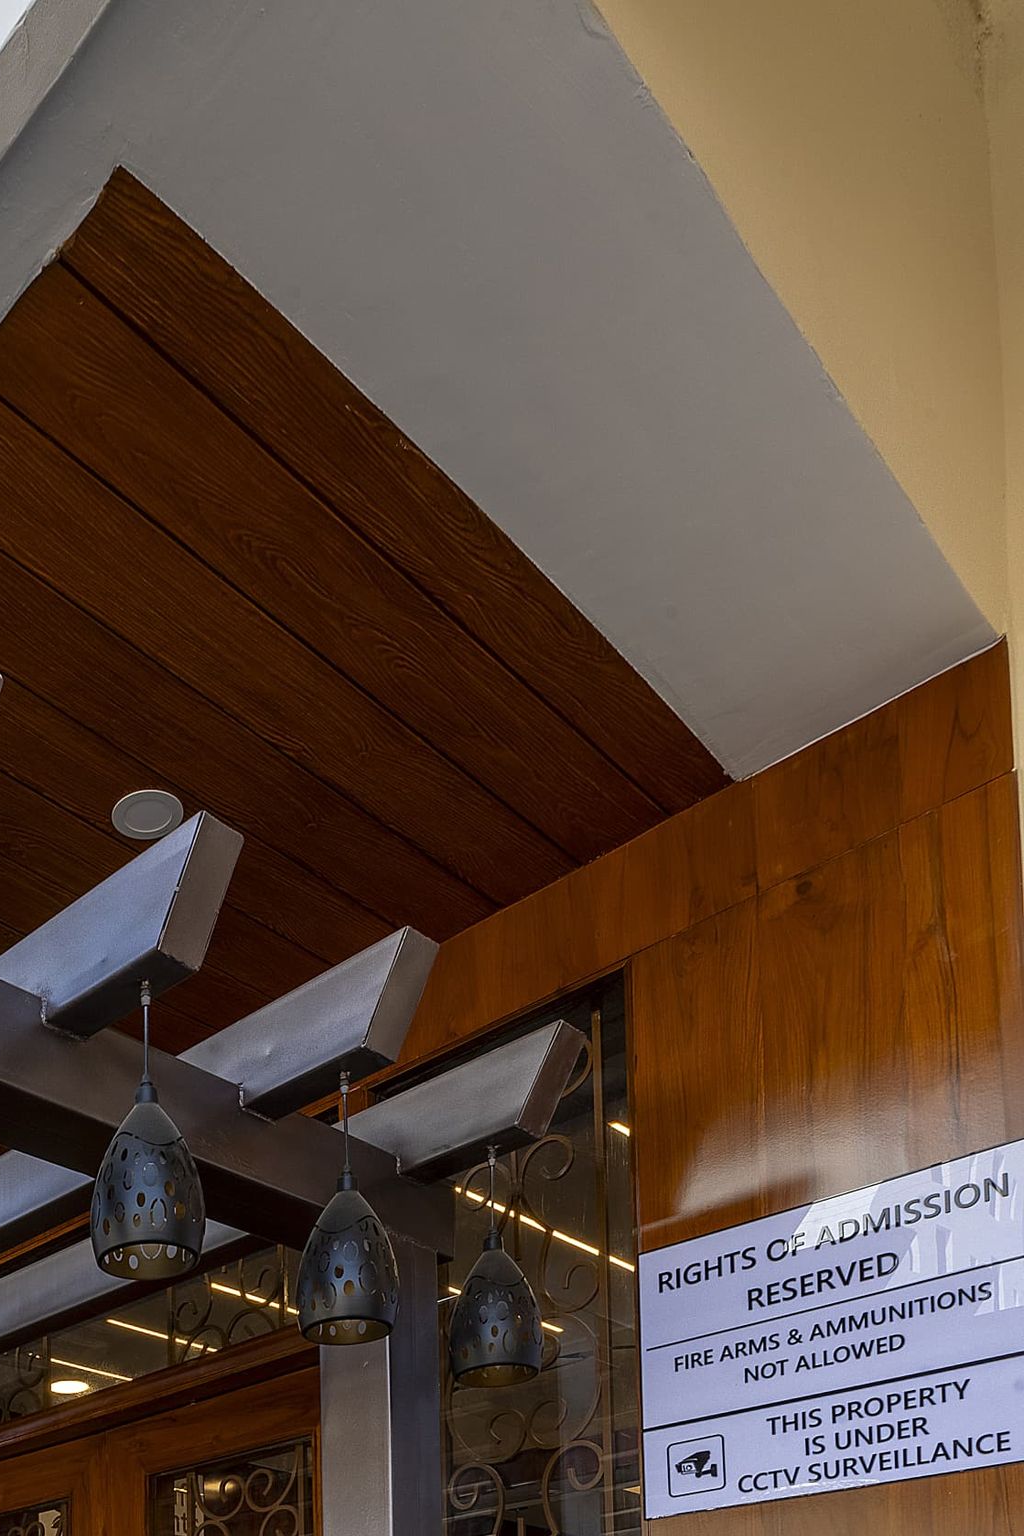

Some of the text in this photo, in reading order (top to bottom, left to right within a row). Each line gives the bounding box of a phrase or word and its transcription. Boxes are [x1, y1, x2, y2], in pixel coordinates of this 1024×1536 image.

[657, 1171, 1011, 1294] RIGHTS OF ADMISSION
[746, 1251, 900, 1311] RESERVED
[673, 1281, 993, 1373] FIRE ARMS & AMMUNITIONS
[743, 1333, 906, 1384] NOT ALLOWED
[765, 1378, 971, 1436] THIS PROPERTY
[804, 1415, 930, 1456] IS UNDER
[737, 1430, 1012, 1494] CCTV SURVEILLANCE
